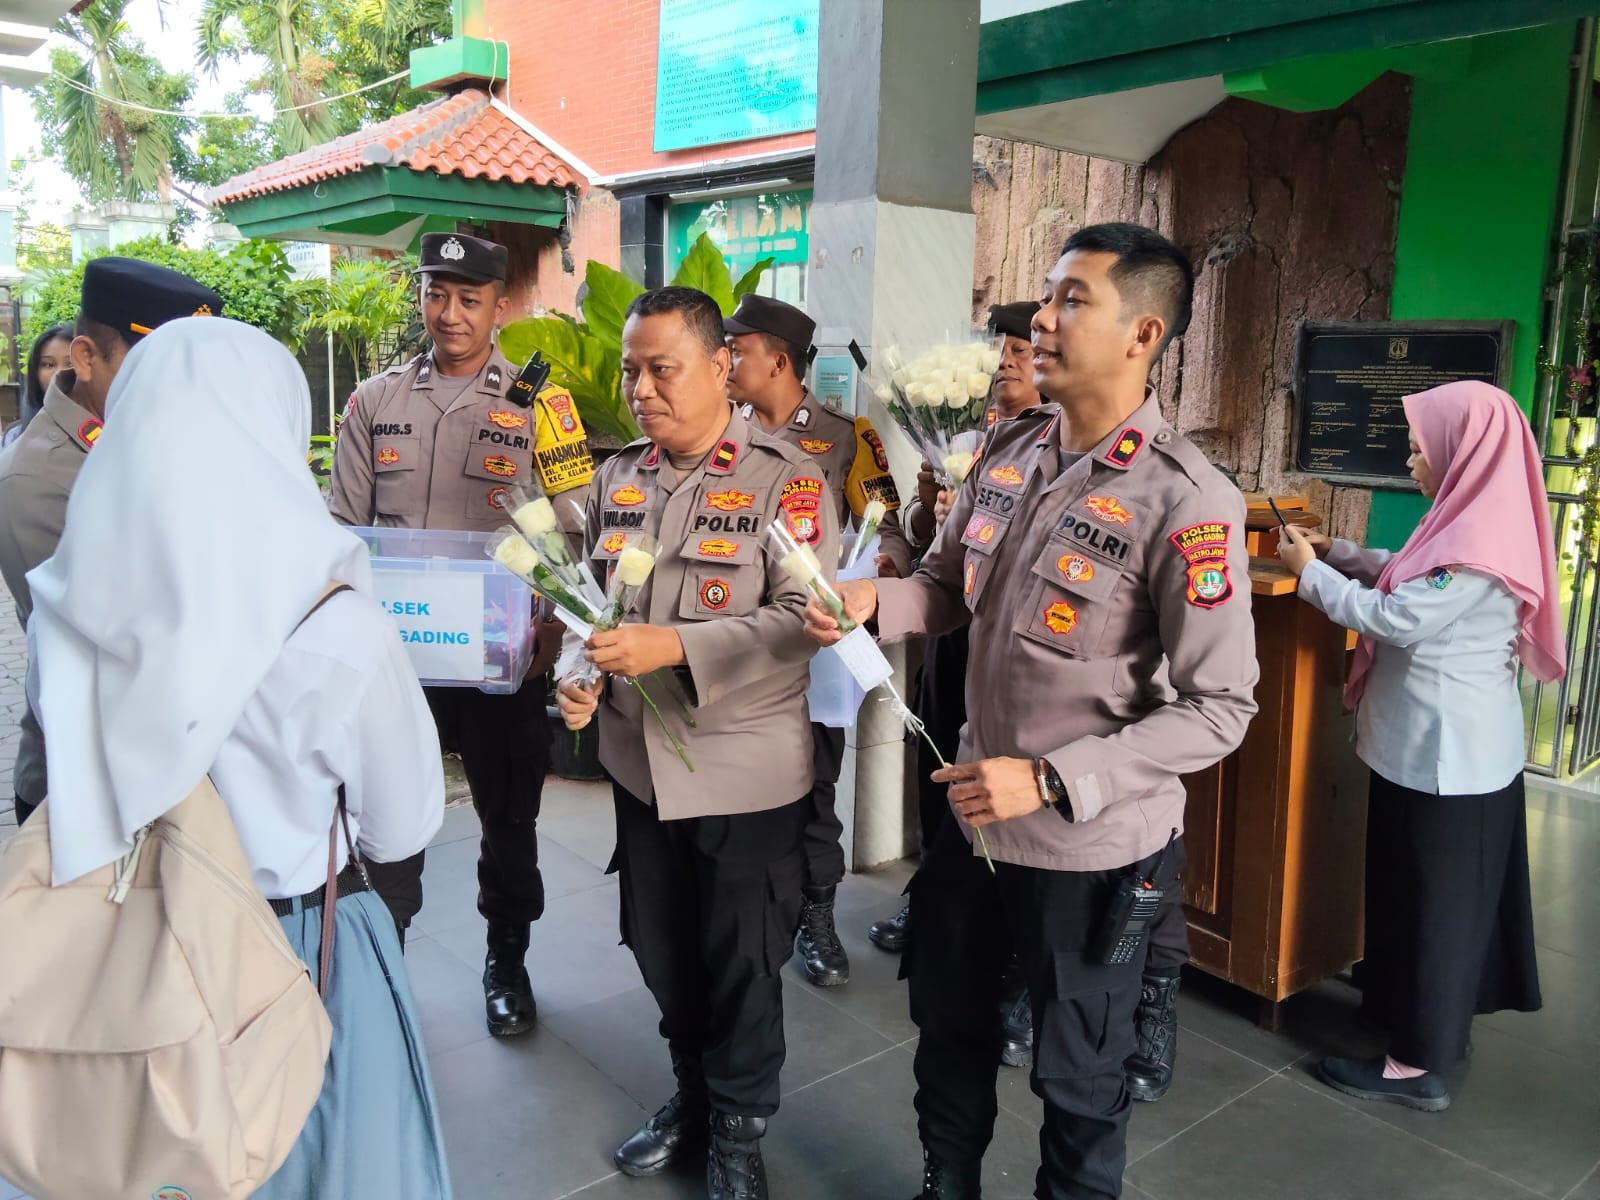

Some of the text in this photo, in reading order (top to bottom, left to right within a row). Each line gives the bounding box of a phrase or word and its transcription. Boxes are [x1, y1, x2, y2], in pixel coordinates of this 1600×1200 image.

[479, 428, 529, 450] POLRI
[978, 487, 1014, 512] SETO
[603, 510, 646, 527] WILSON
[694, 515, 759, 532] POLRI
[1060, 515, 1128, 559] POLRI
[1182, 524, 1224, 540] POLSEK
[400, 630, 470, 645] GADING
